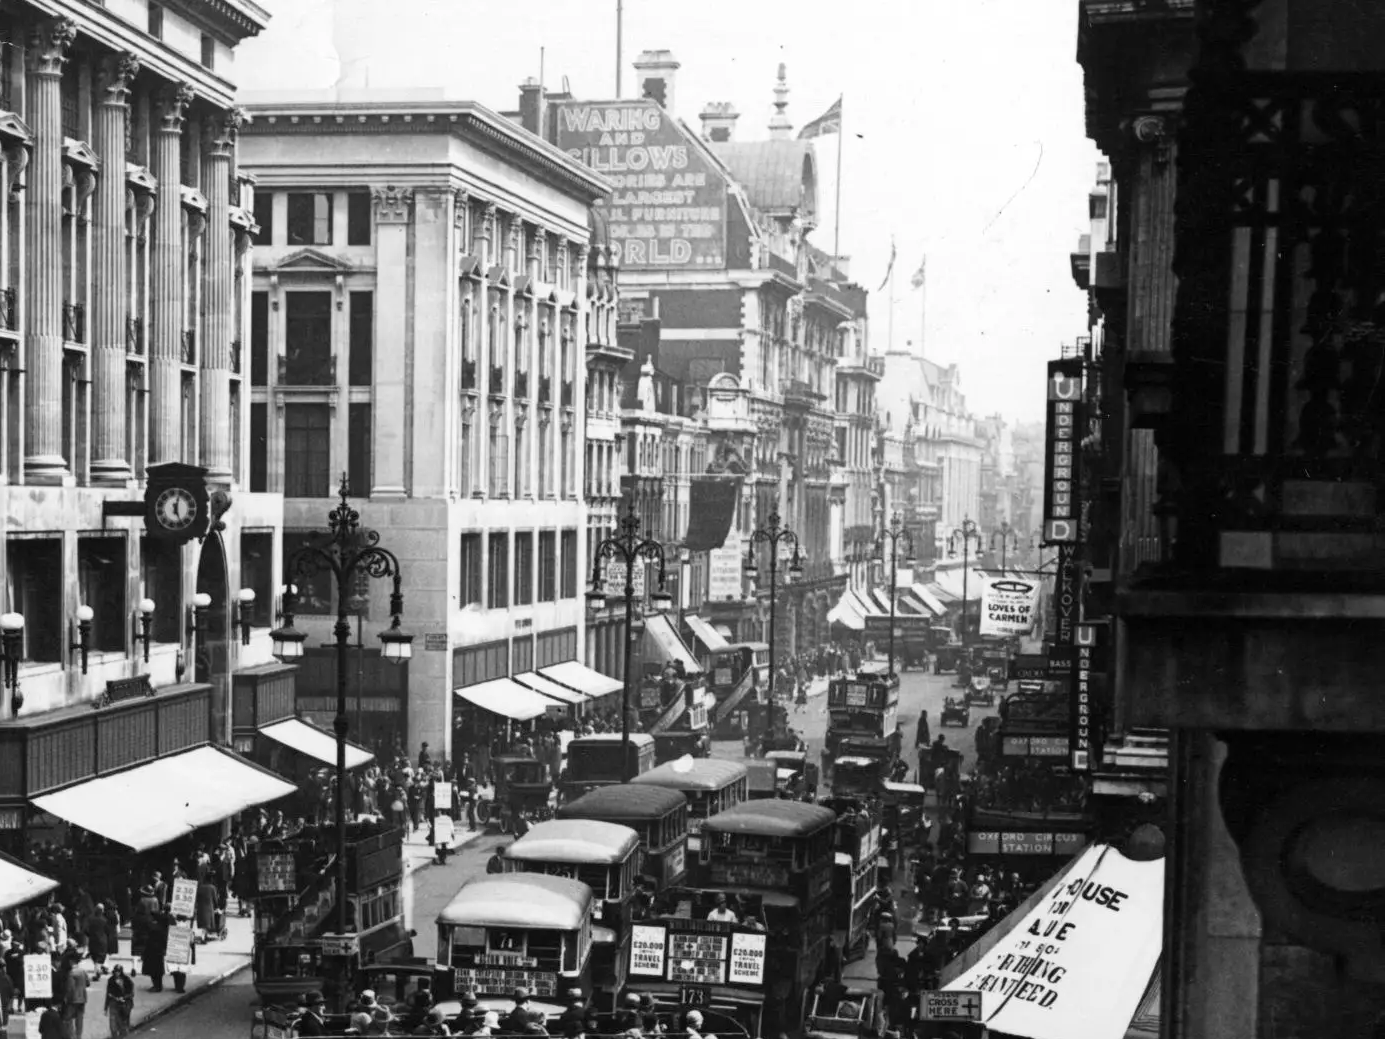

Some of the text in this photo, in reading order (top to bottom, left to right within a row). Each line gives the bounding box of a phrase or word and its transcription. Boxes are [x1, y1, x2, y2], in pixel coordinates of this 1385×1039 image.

[564, 108, 661, 132] WARING
[599, 132, 645, 146] AND
[1051, 374, 1076, 540] UNDERGROUND
[988, 604, 1031, 614] LOVES OF
[989, 612, 1028, 623] CARMEN
[978, 833, 1078, 843] OXFORD CIRCUS
[1002, 844, 1052, 853] STATION
[634, 954, 661, 962] TRAVEL
[734, 961, 760, 970] TRAVEL
[681, 988, 704, 1004] 173
